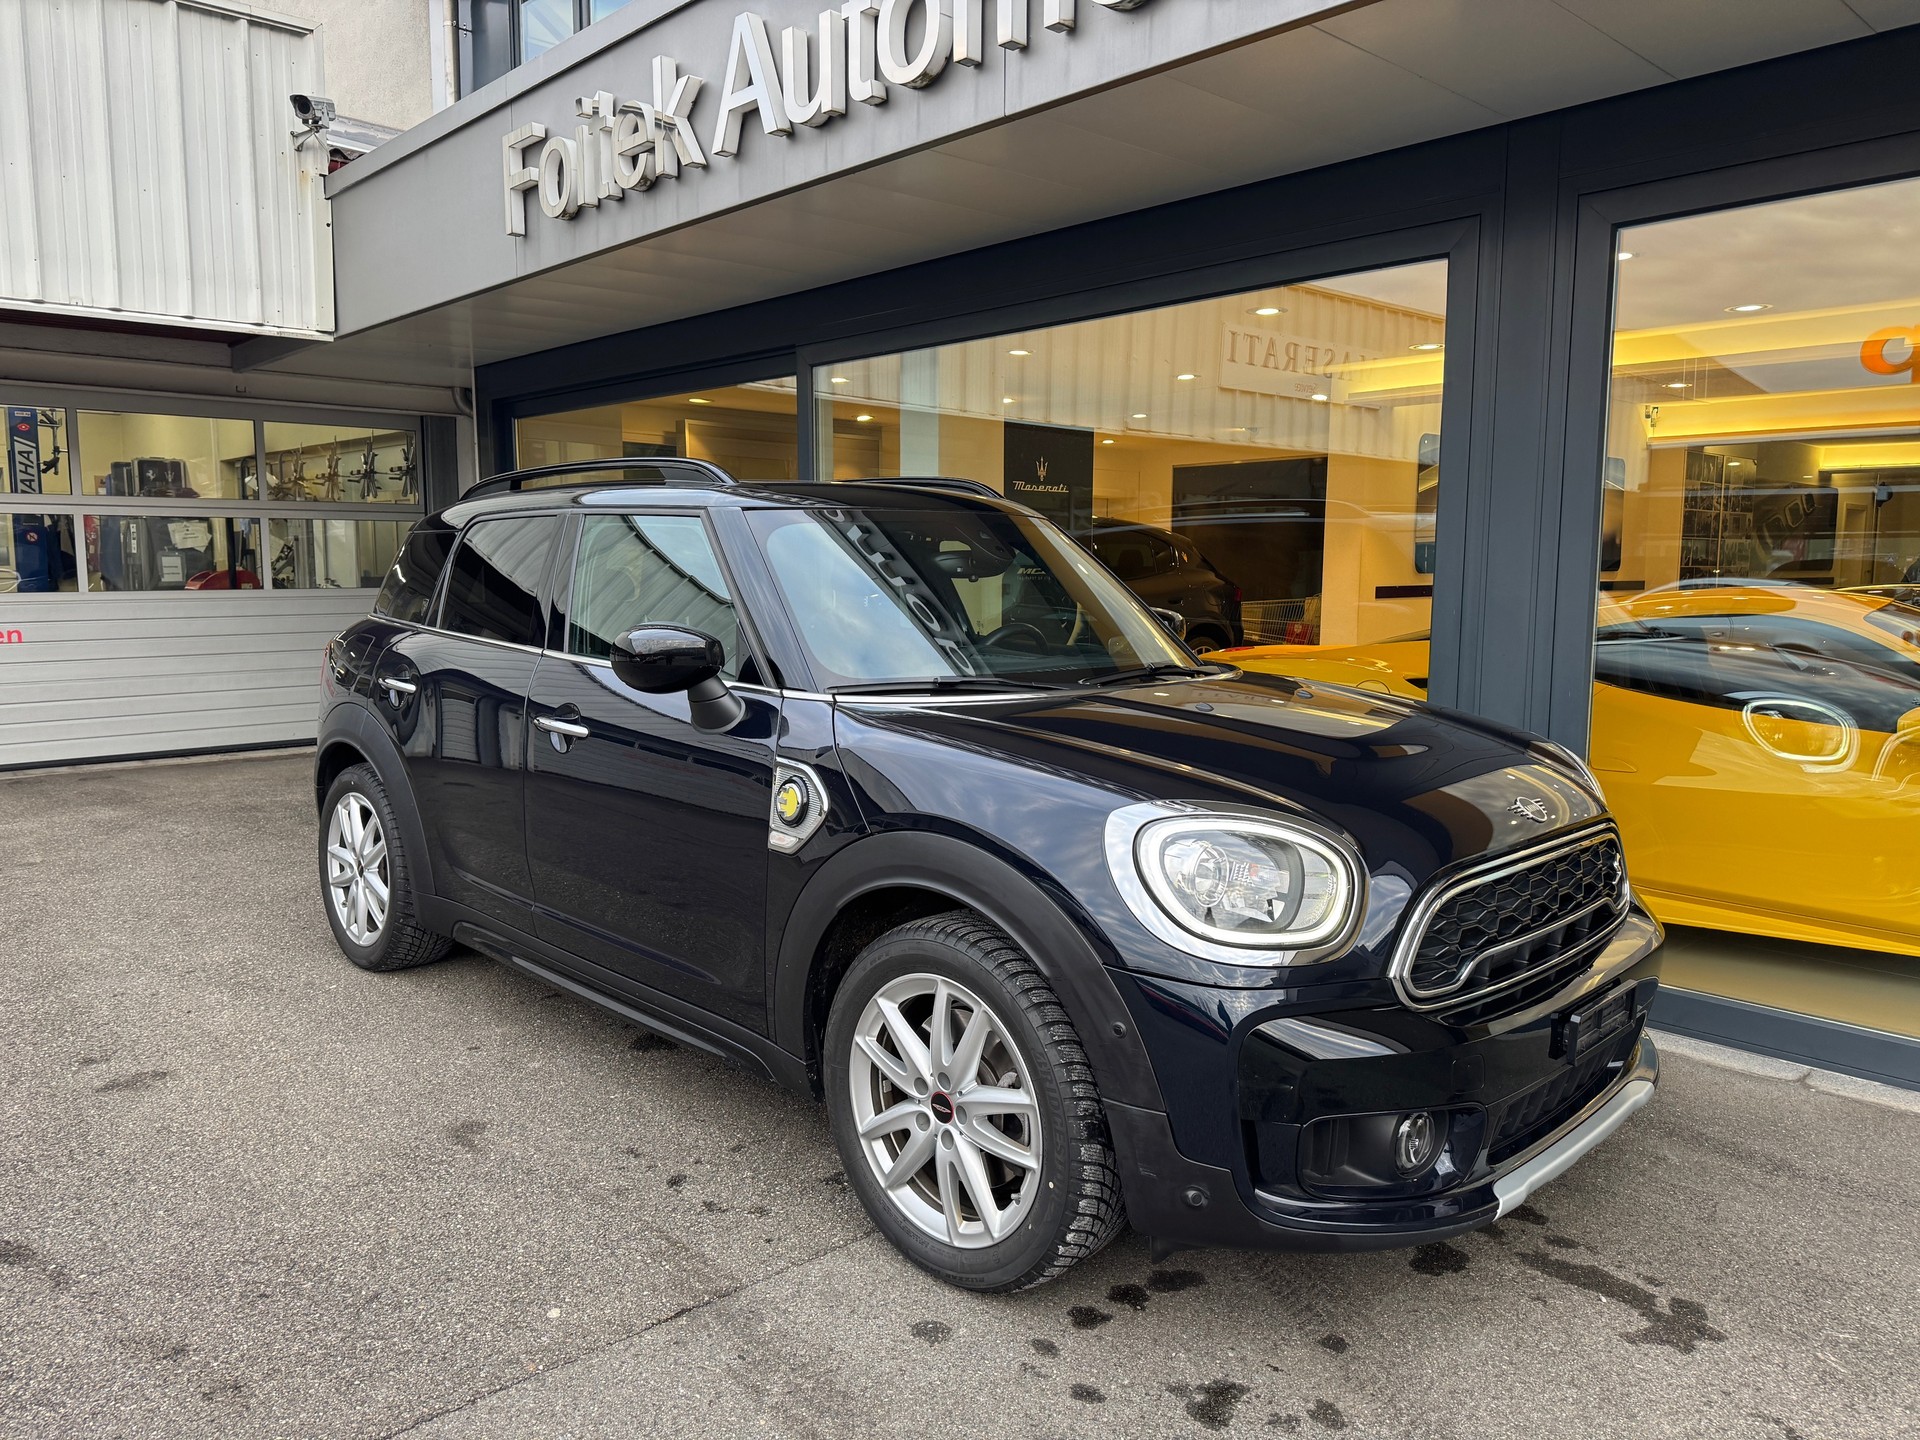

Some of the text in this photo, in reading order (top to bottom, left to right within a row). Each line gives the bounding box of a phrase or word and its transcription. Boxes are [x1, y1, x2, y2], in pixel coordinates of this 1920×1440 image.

[502, 0, 1146, 237] Foitek Auto
[20, 450, 36, 494] AHA
[1012, 480, 1070, 493] Maserati
